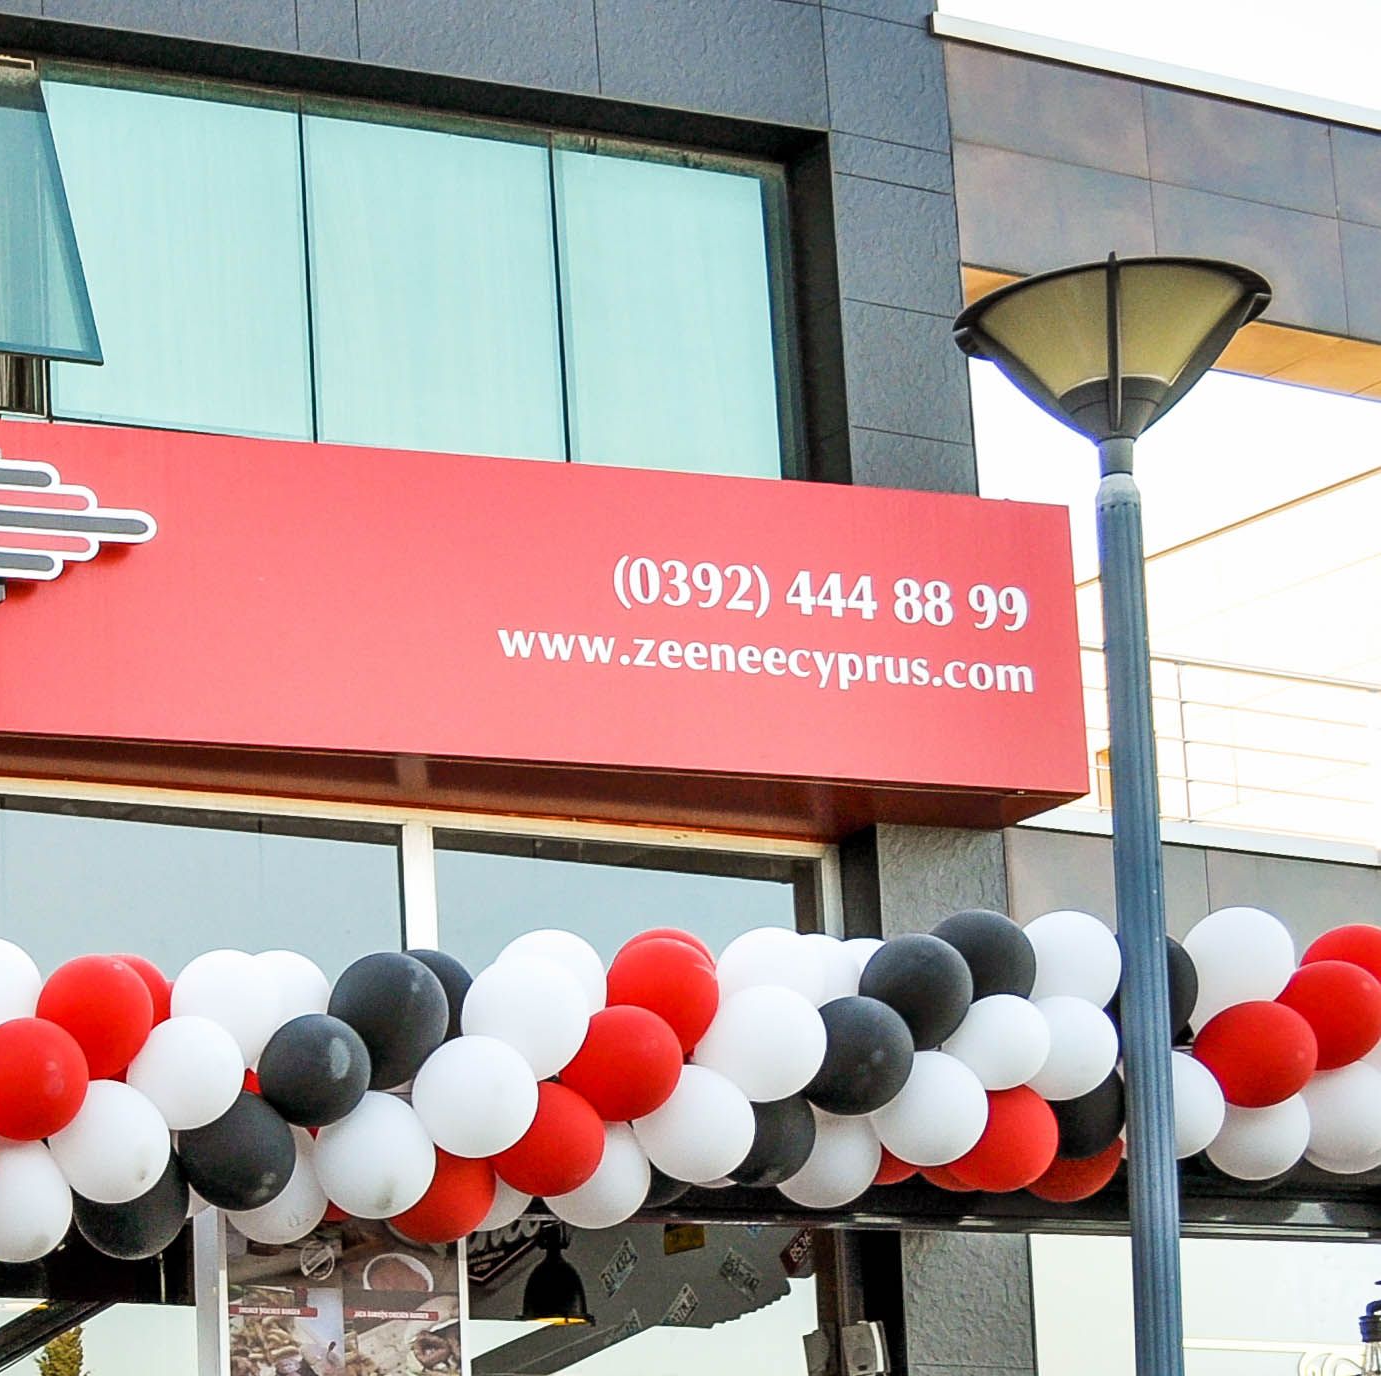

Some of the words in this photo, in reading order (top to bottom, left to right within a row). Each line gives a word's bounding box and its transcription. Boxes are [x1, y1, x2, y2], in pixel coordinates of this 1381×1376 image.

[613, 554, 770, 618] (0392)
[786, 571, 877, 620] 444
[893, 577, 954, 626] 88
[968, 583, 1028, 632] 99
[497, 628, 1034, 693] www.zeeneecyprus.com
